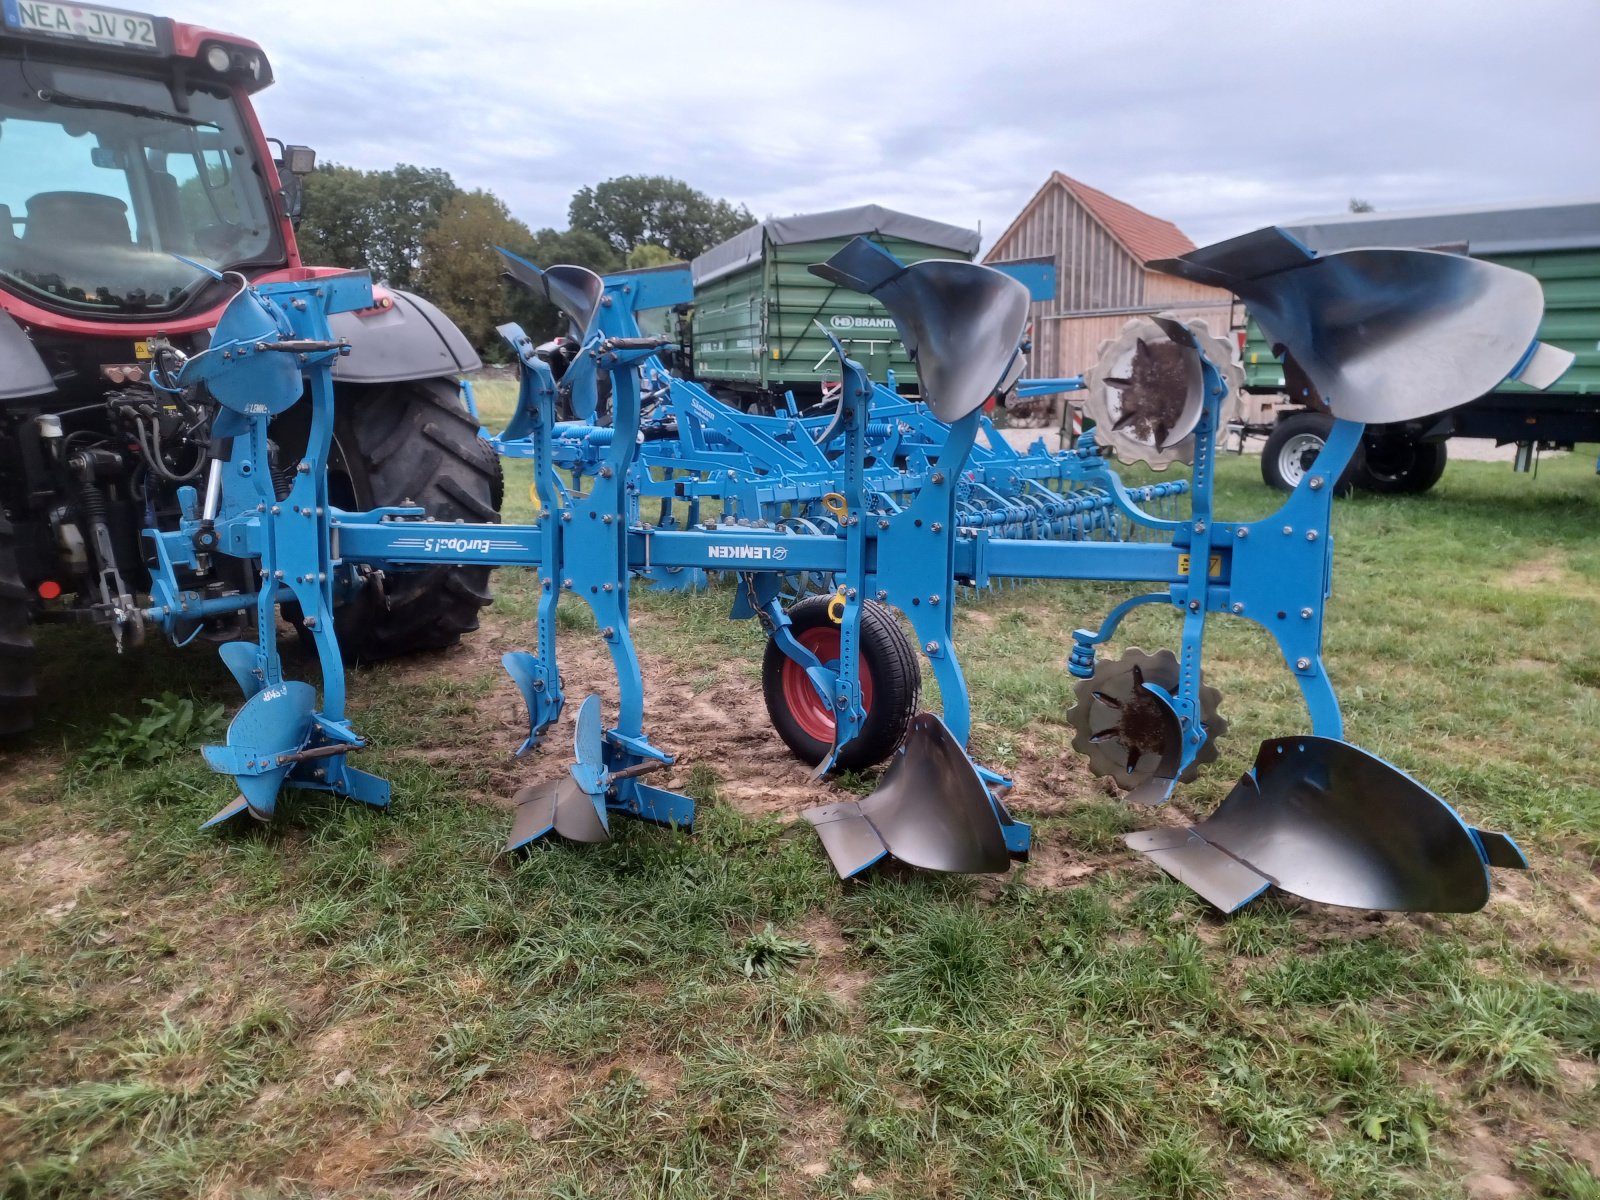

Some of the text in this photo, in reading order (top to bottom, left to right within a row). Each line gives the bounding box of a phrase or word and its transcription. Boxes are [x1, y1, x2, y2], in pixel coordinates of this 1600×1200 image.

[18, 3, 71, 31] NEA
[88, 12, 118, 37] JV
[124, 19, 154, 44] 92
[424, 538, 434, 552] 5
[708, 544, 771, 560] LEMKEN
